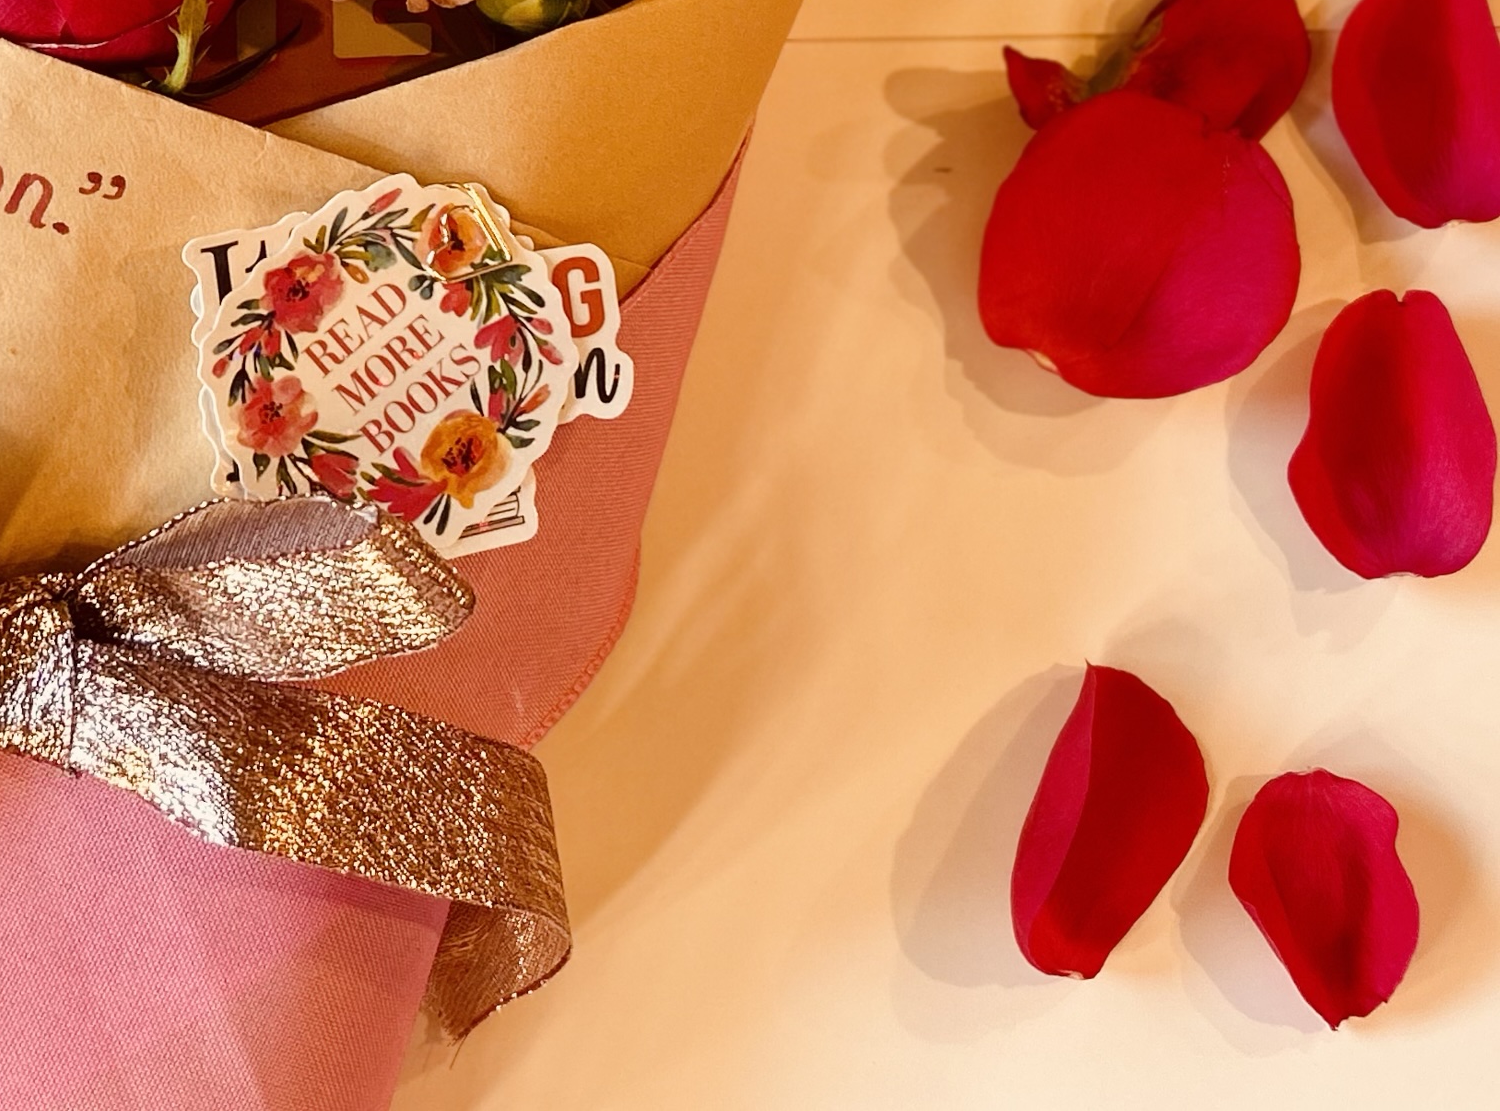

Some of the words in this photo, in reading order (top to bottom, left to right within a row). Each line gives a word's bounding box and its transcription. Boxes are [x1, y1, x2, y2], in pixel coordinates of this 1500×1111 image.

[301, 283, 407, 378] READ
[332, 314, 445, 416] MORE
[357, 343, 482, 456] BOOKS
